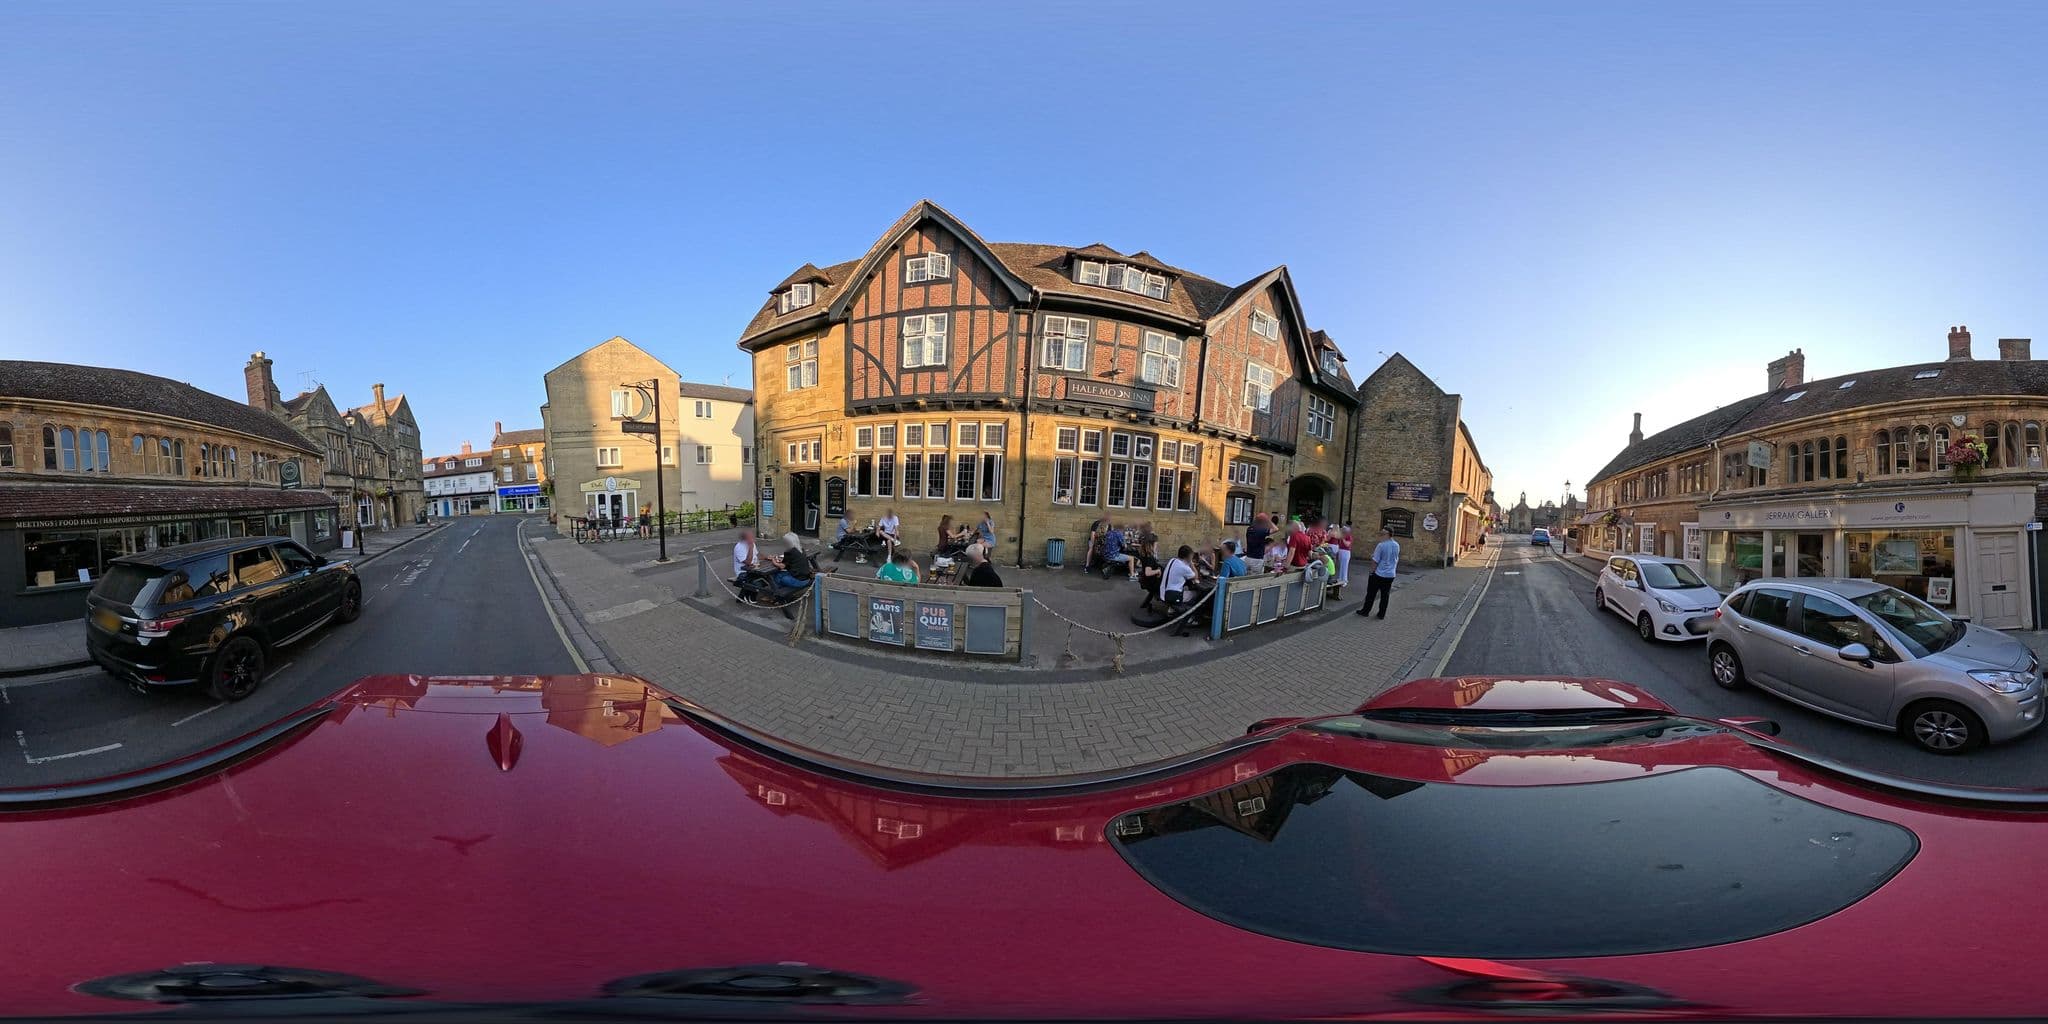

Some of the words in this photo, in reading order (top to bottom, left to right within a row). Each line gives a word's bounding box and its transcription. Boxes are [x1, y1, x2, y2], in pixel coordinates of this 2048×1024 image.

[1072, 383, 1098, 393] HALF
[1132, 391, 1151, 402] INN
[1797, 509, 1834, 519] GALLERY
[16, 520, 54, 528] MEETINGS
[872, 602, 901, 613] DARTS
[922, 606, 946, 617] PUB
[919, 615, 949, 627] QUIZ
